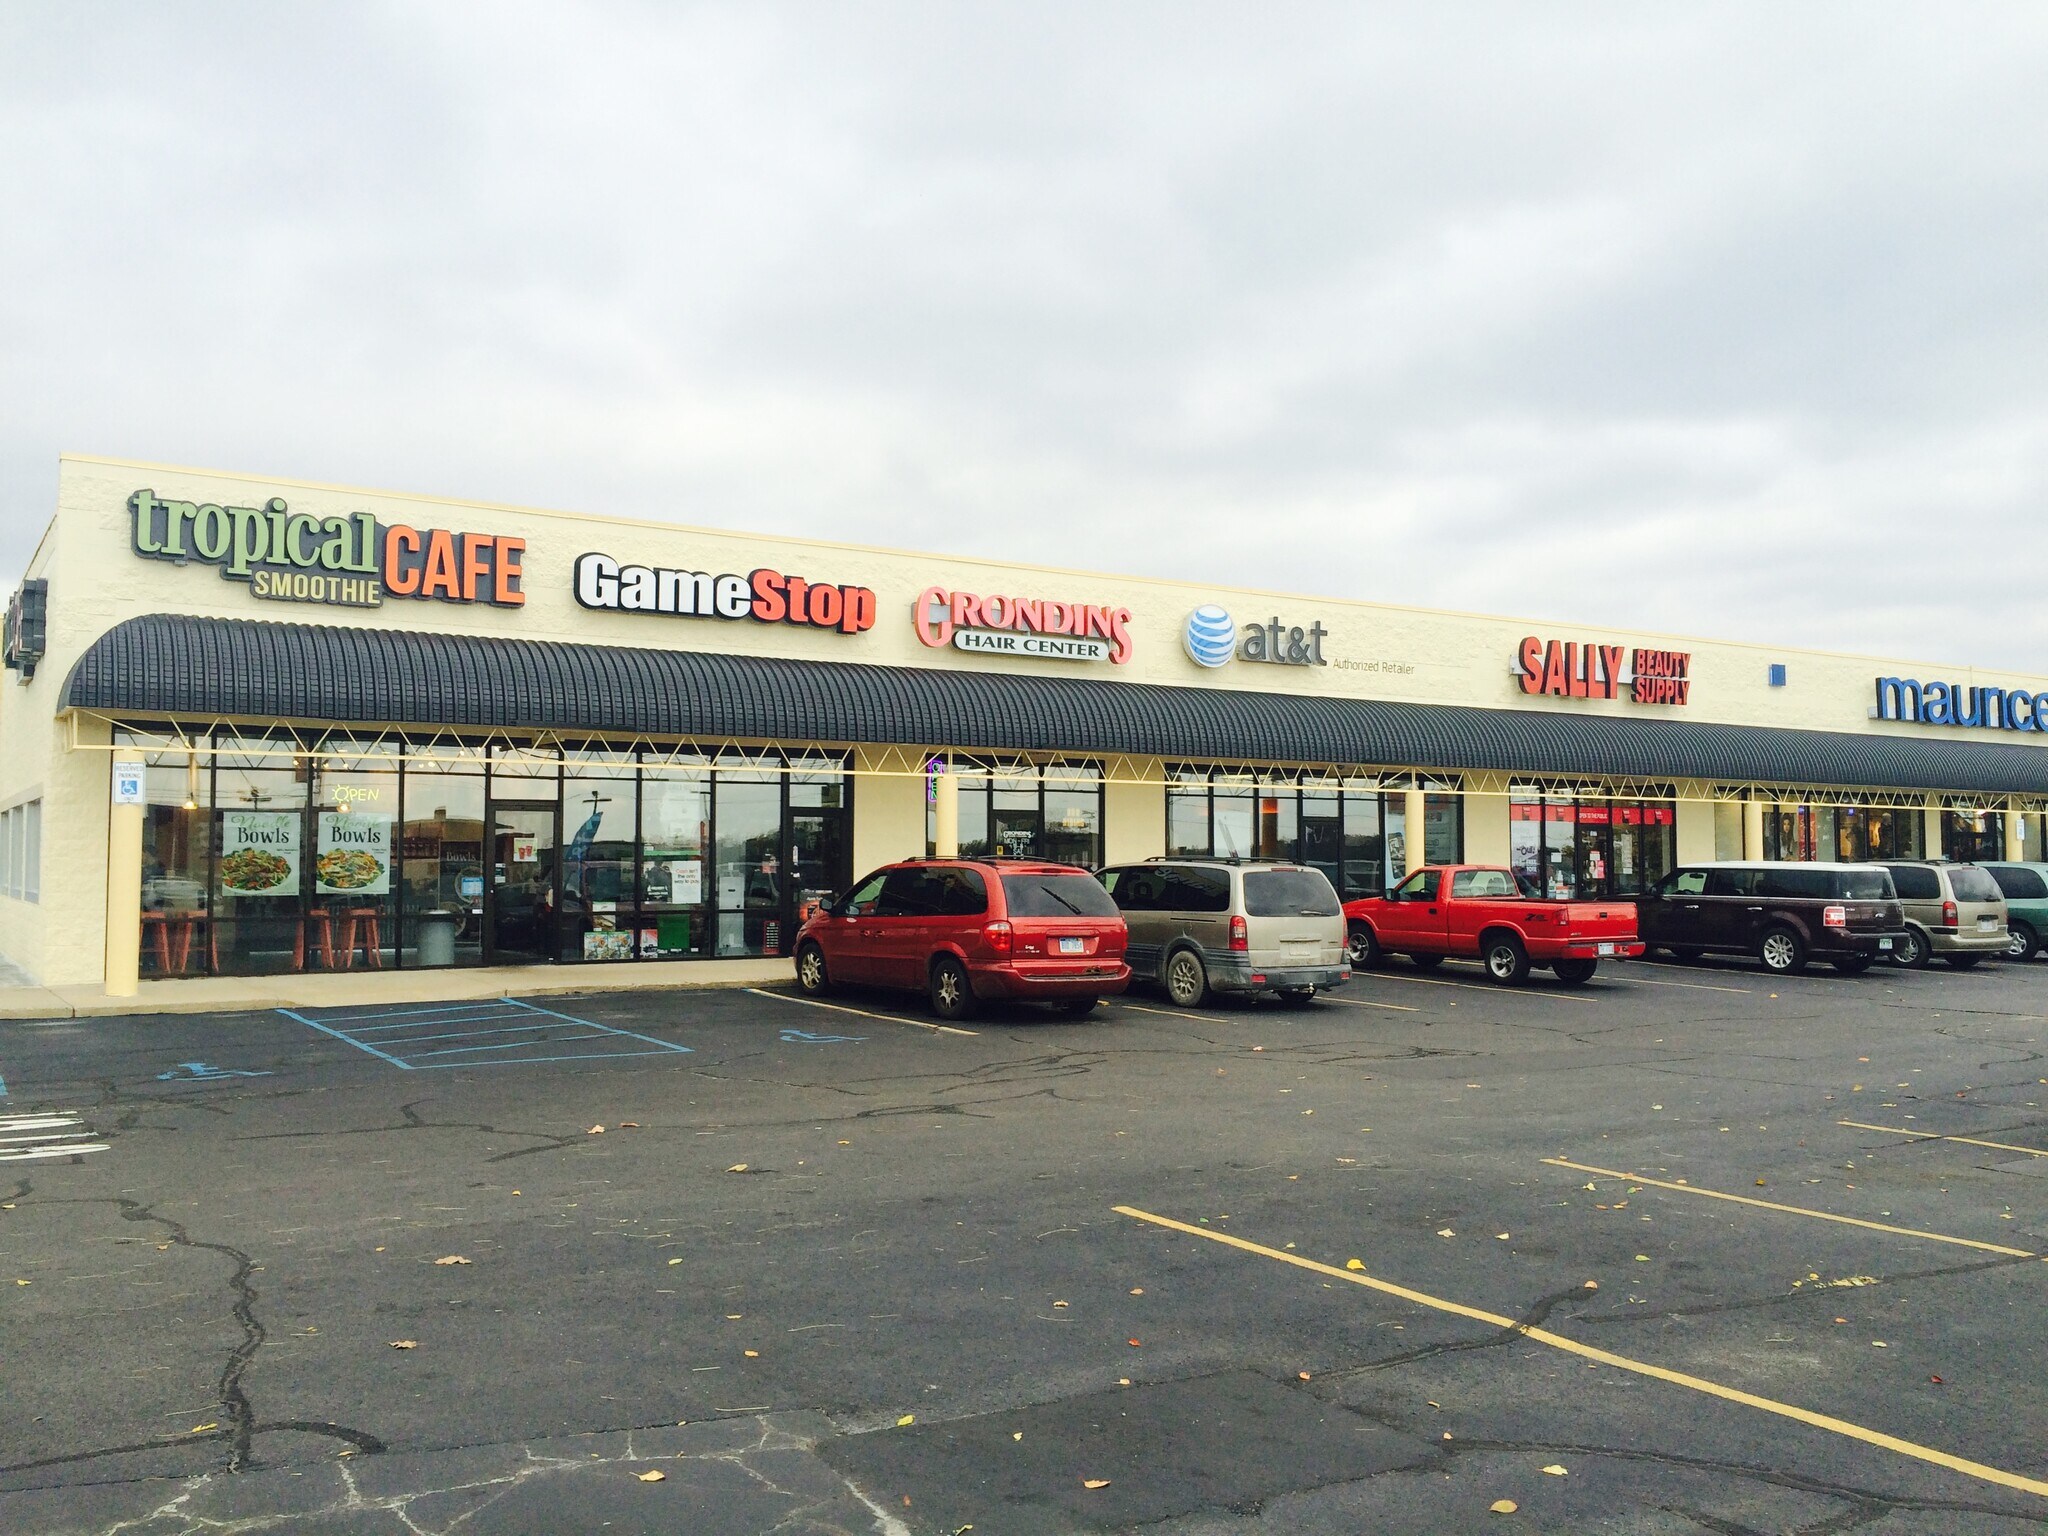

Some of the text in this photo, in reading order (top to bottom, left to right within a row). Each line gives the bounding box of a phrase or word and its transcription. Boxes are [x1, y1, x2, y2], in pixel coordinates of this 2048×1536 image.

[133, 489, 380, 576] tropical
[385, 523, 526, 604] CAFE
[254, 570, 381, 604] SMOOTHIE
[575, 552, 876, 634] GameStop
[914, 586, 1133, 665] GRONDINS
[1241, 616, 1328, 667] at&t
[965, 634, 1100, 657] HAIR CENTER
[1333, 657, 1415, 675] Authorized Retailer
[1518, 636, 1625, 700] SALLY
[1632, 648, 1692, 678] BEAUTY
[1631, 677, 1691, 706] SUPPLY
[332, 784, 379, 803] OPEN
[238, 826, 290, 844] Bowls
[331, 826, 381, 843] Bowls
